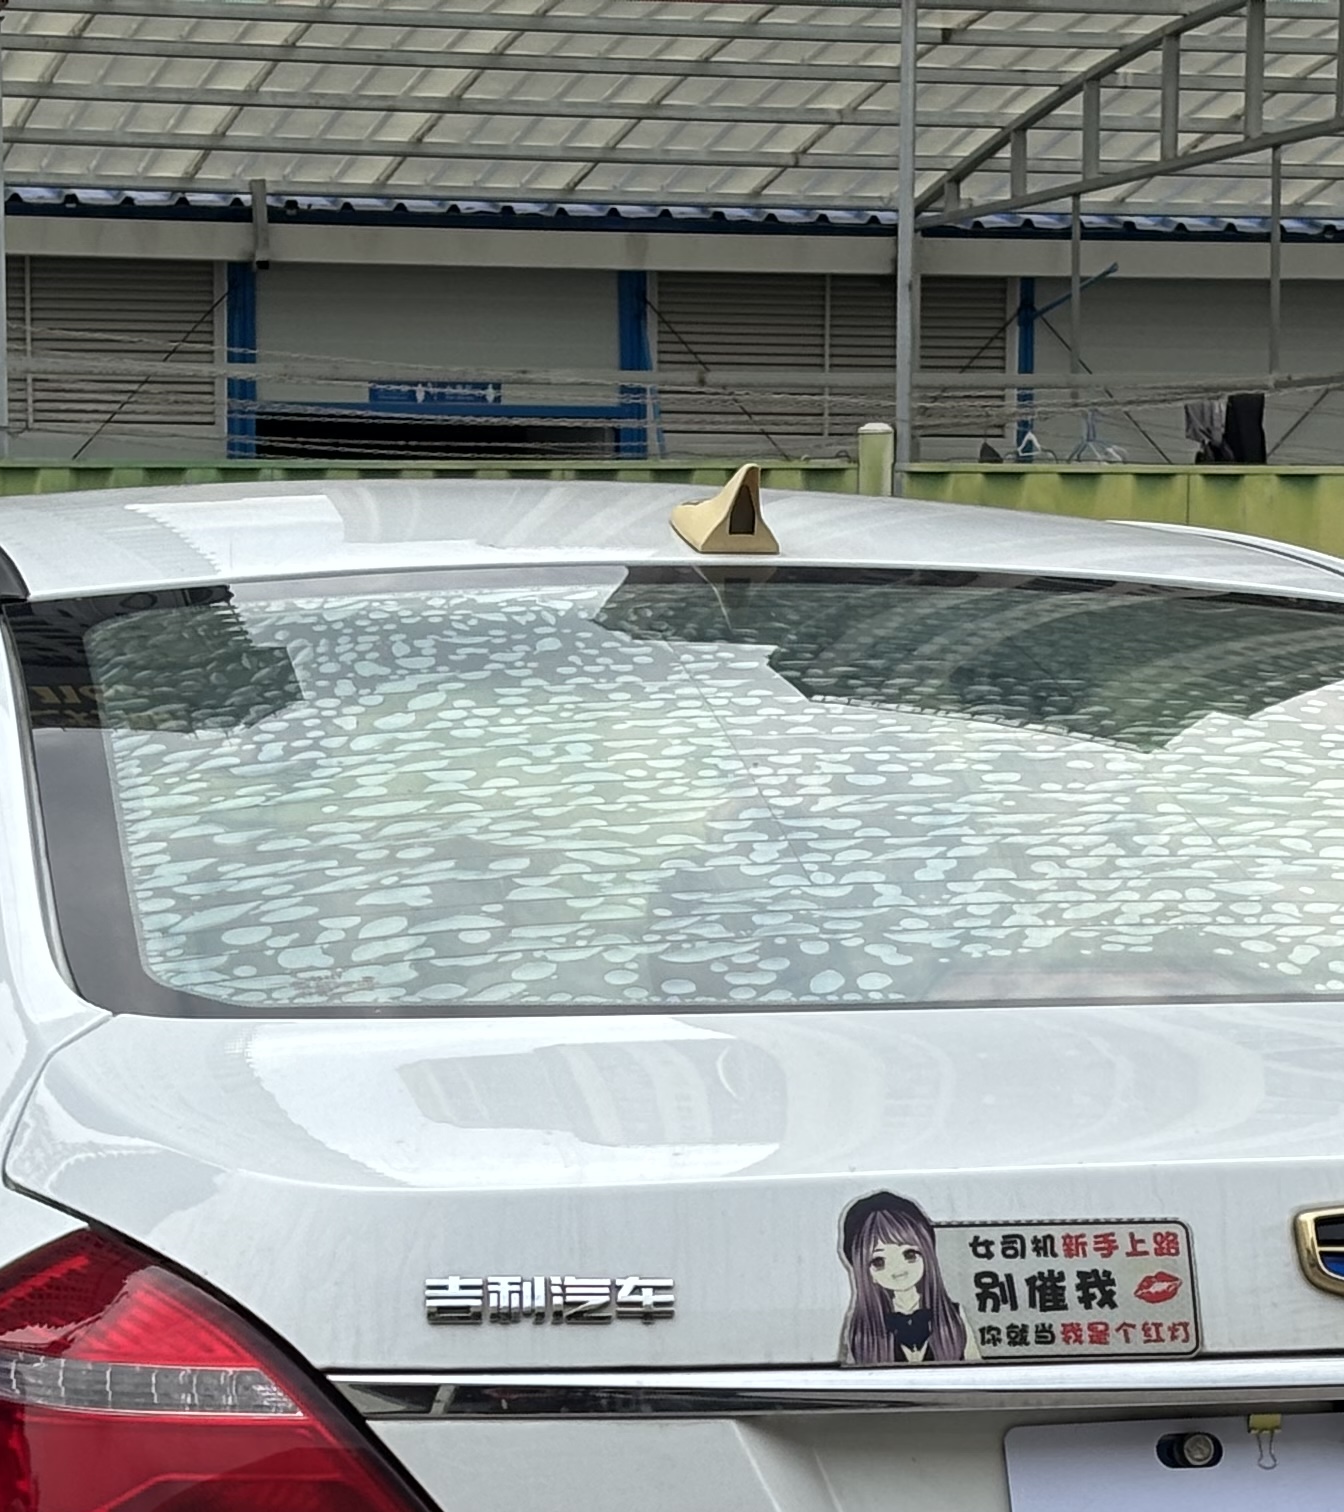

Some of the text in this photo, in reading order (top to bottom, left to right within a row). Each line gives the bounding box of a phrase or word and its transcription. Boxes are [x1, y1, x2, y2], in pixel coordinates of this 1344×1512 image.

[968, 1231, 1181, 1260] 女司机新手上路
[425, 1275, 675, 1325] 吉利汽车
[973, 1268, 1119, 1314] 别催我
[978, 1321, 1190, 1347] 你就当我是个红灯
